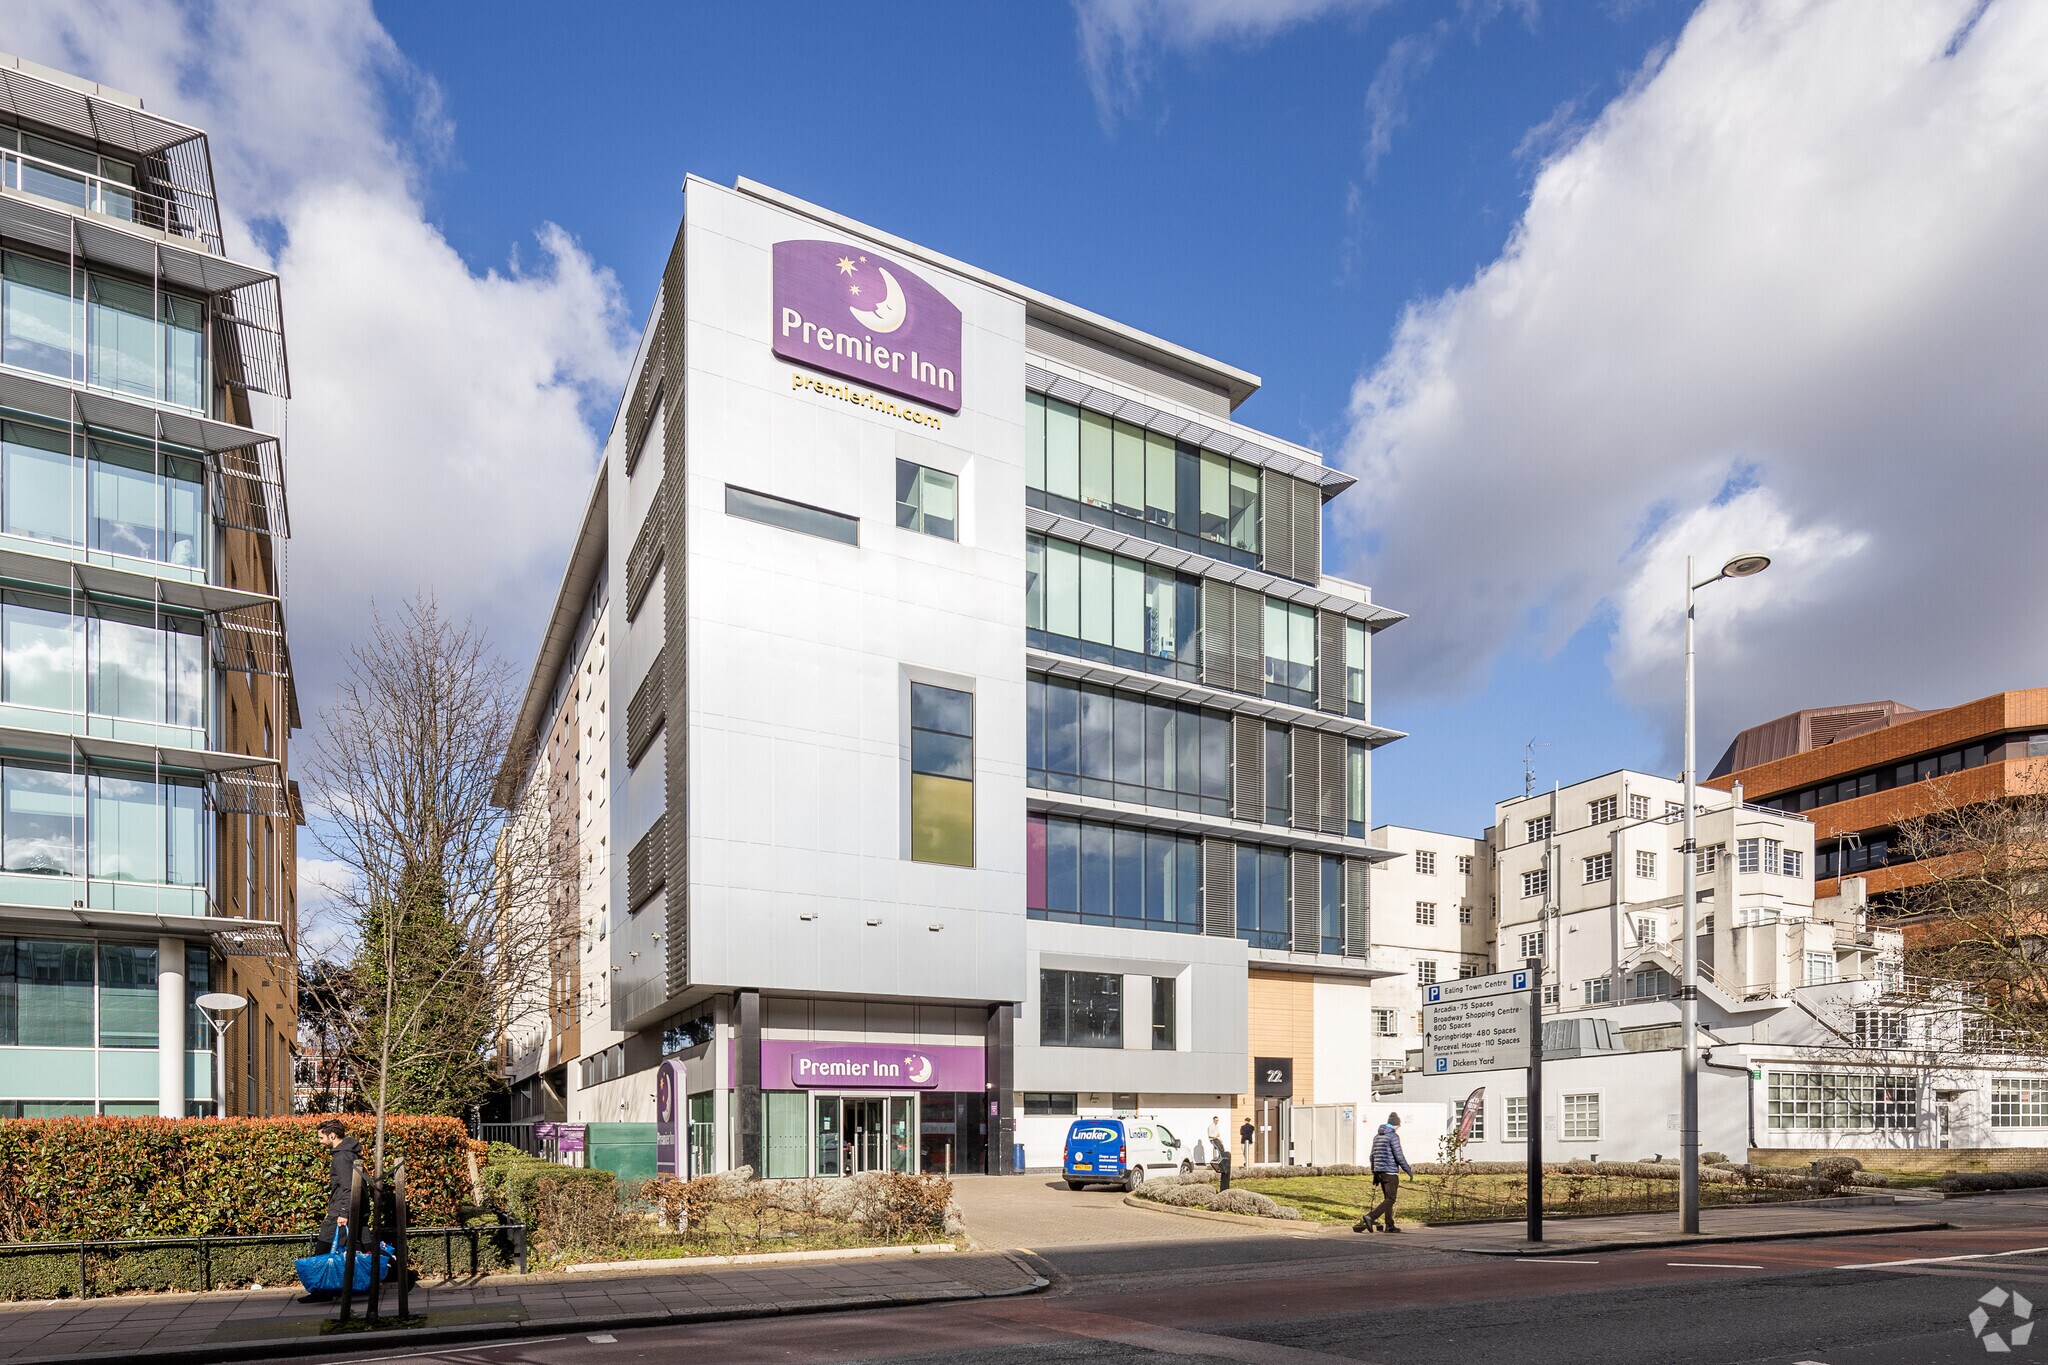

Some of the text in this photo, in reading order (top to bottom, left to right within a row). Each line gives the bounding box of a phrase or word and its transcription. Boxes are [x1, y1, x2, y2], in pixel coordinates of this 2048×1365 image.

[782, 306, 954, 392] Premier Inn
[792, 371, 941, 430] premierinn.com
[1485, 980, 1507, 988] Centre
[1471, 1001, 1493, 1009] Spaces
[1434, 1015, 1463, 1023] Broadway
[1466, 1010, 1495, 1019] Shopping
[1450, 1022, 1471, 1030] Spaces
[1434, 1043, 1459, 1051] Perceval
[1479, 1056, 1494, 1064] Yard
[800, 1059, 899, 1076] Premier Inn
[1267, 1070, 1282, 1082] 22
[1073, 1128, 1108, 1140] Linaker
[1129, 1128, 1148, 1138] Linaker
